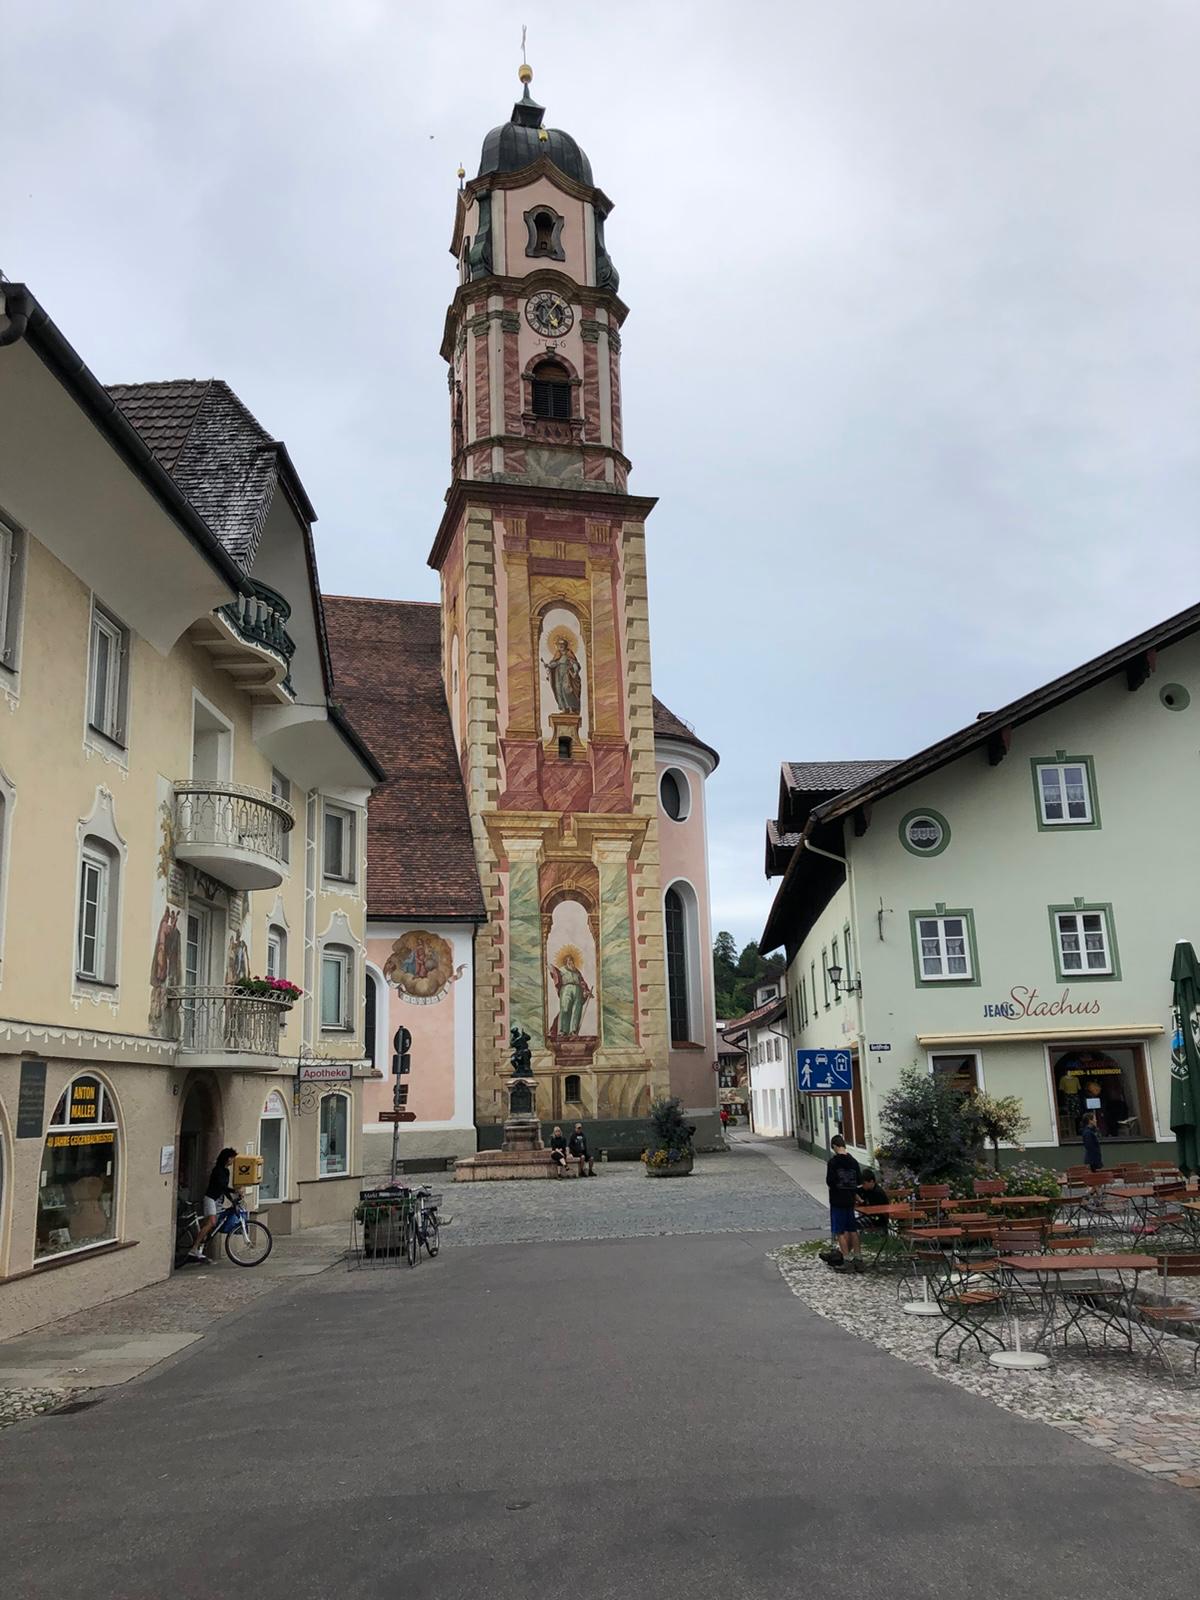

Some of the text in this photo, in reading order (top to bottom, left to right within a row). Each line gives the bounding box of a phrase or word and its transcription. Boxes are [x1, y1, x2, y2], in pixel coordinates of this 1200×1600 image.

[983, 985, 1101, 1021] JEANS Stachus
[303, 1068, 348, 1079] Apotheke
[73, 1086, 96, 1100] ANTON
[70, 1104, 96, 1118] MALLER
